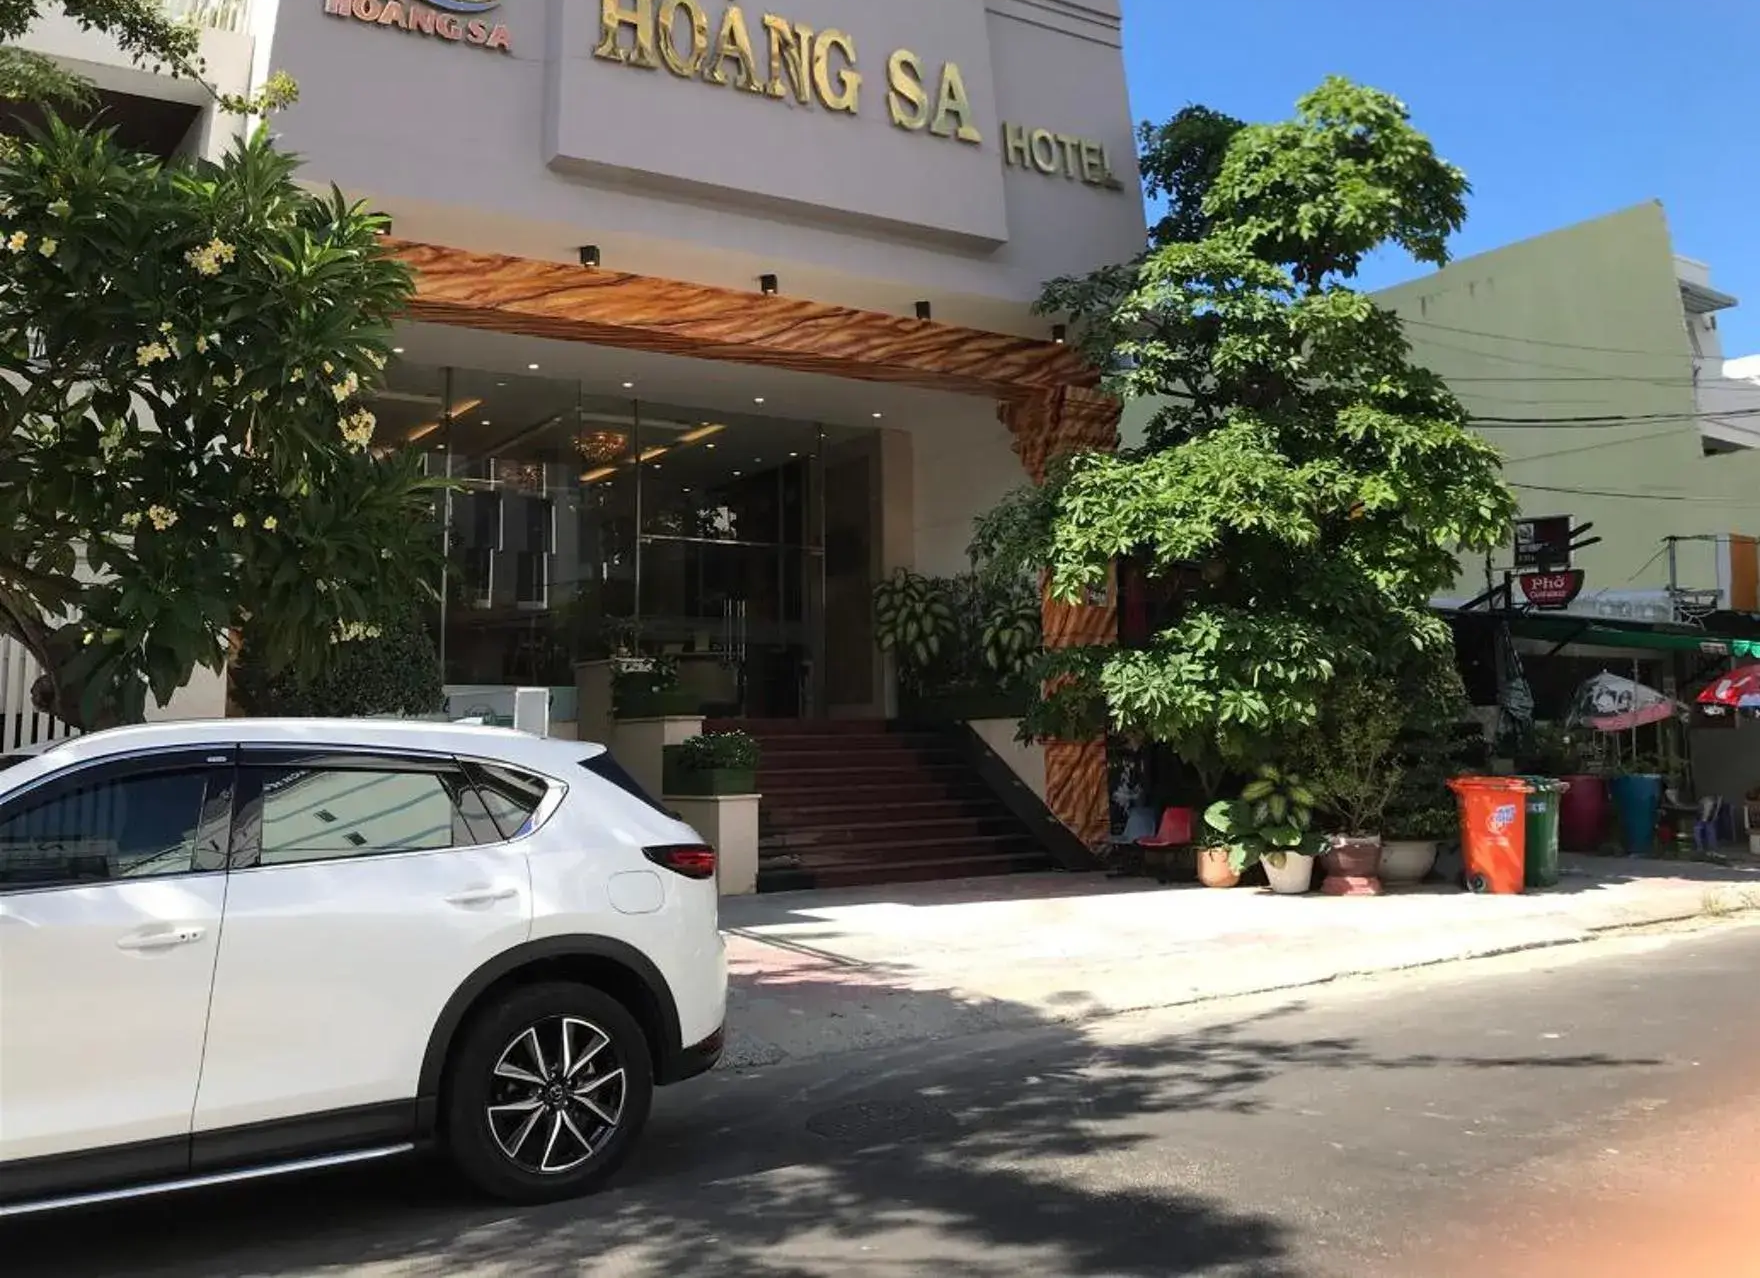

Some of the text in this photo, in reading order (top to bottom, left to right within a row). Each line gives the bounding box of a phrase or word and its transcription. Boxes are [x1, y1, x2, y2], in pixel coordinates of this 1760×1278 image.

[466, 19, 514, 52] SA
[885, 48, 983, 144] SA
[1002, 120, 1125, 191] HOTEL
